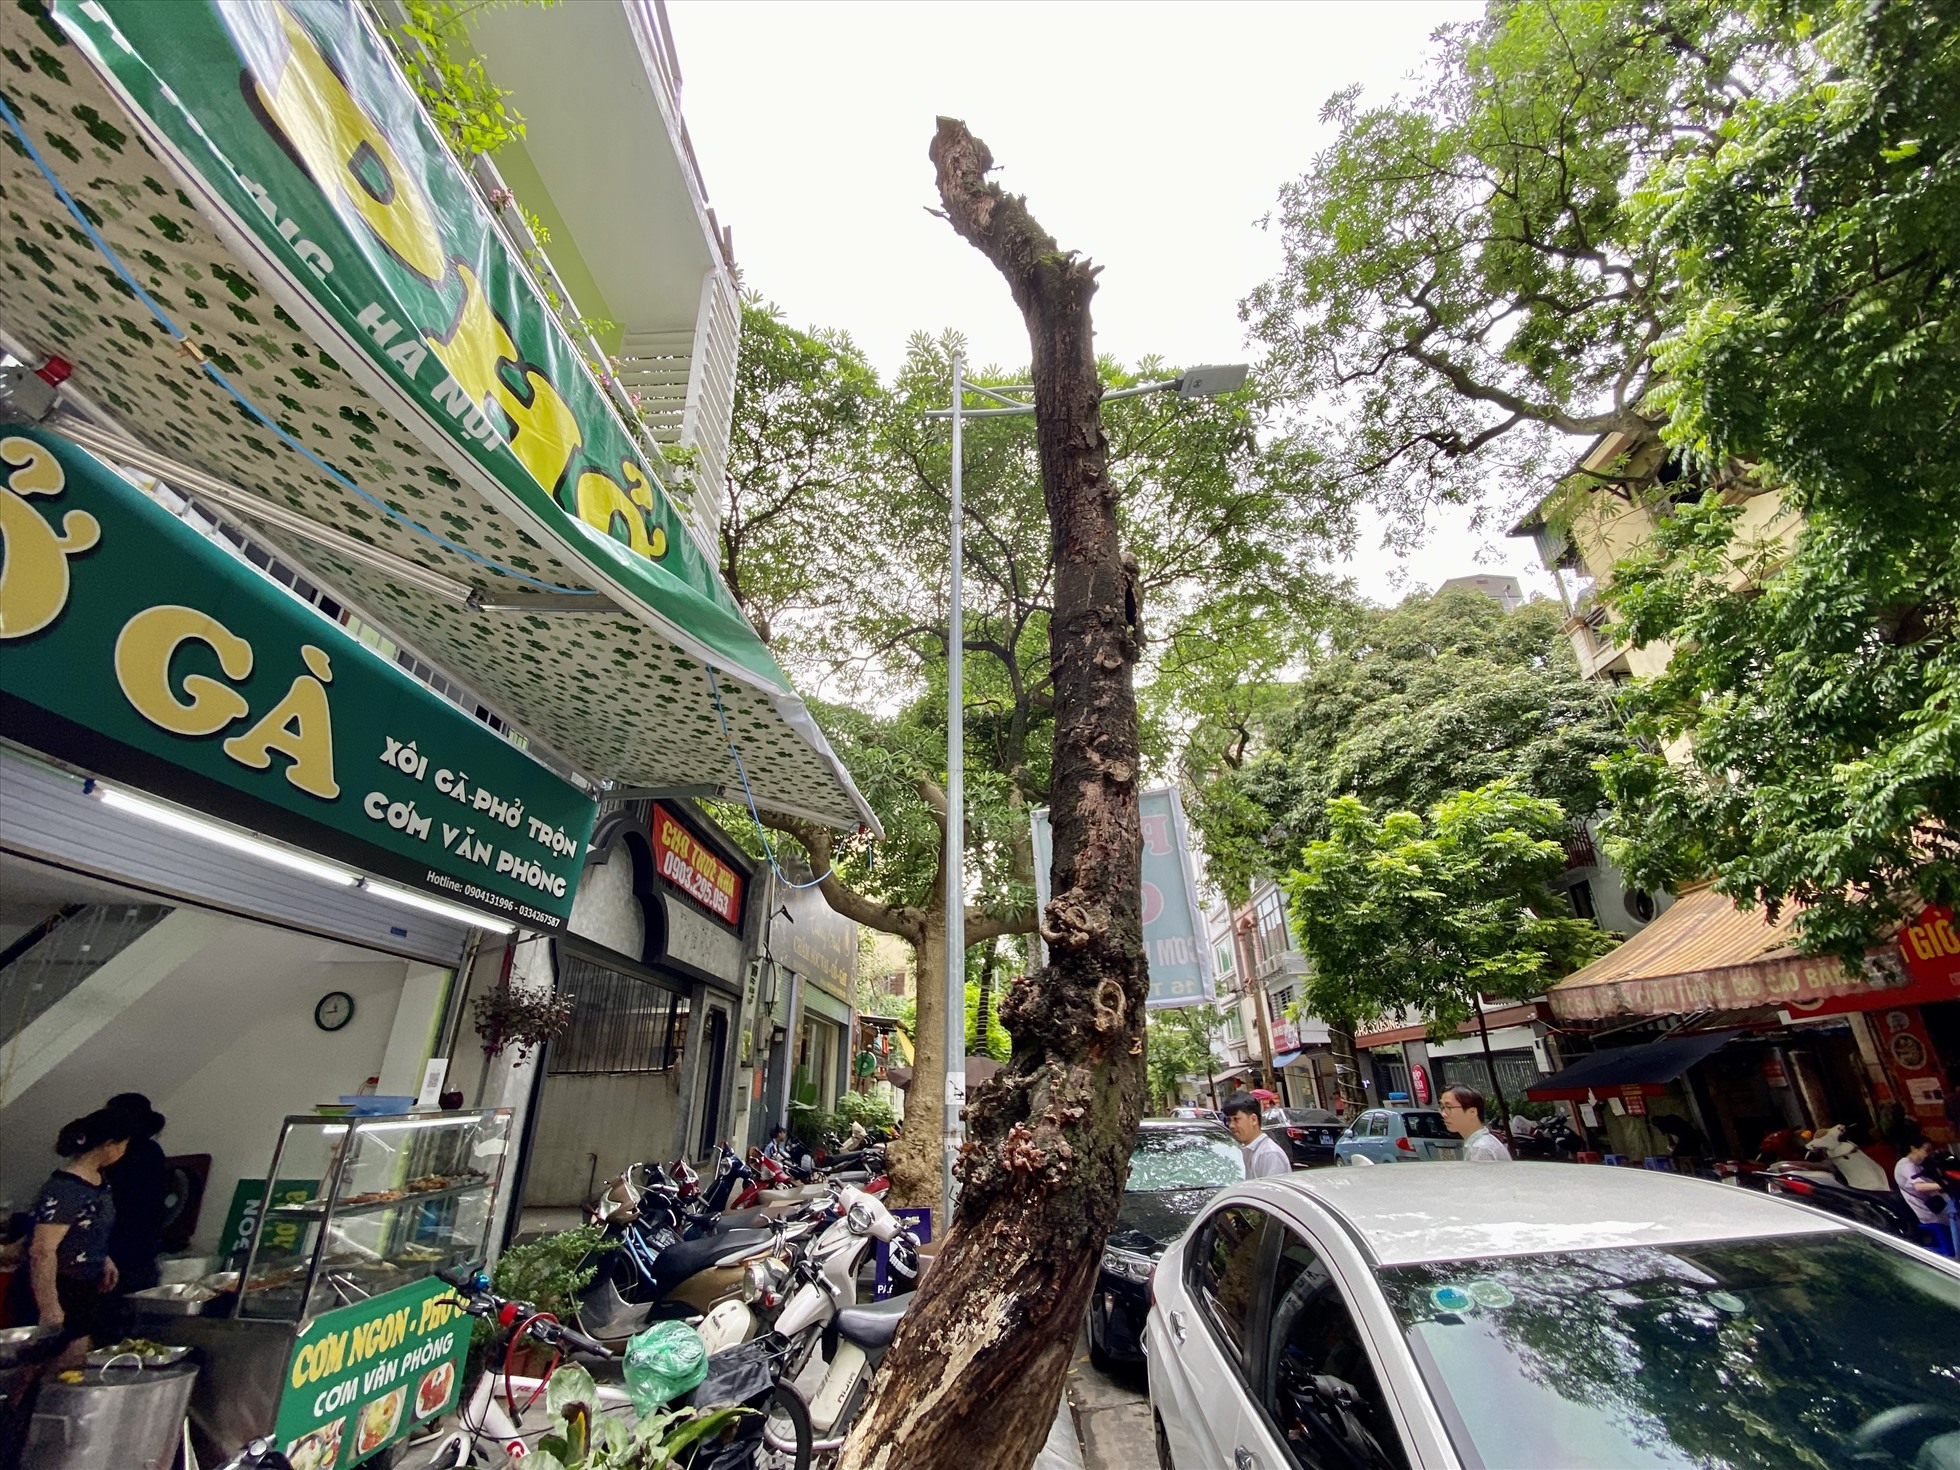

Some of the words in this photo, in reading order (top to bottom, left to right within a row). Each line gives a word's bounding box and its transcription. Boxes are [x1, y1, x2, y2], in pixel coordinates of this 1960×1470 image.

[115, 605, 340, 799] GÀ
[379, 736, 429, 781] XÔI
[528, 816, 578, 859] TRỘN
[661, 820, 690, 858] CHO
[363, 791, 432, 841] CƠM
[442, 823, 494, 866] VĂN
[496, 850, 568, 898] PHÒNG
[663, 850, 729, 915] 0903.295.053
[426, 870, 463, 893] Hotline:
[464, 884, 513, 911] 0904131996
[519, 905, 560, 928] 0334267587
[291, 1330, 349, 1389] CƠM
[347, 1307, 411, 1367] NGON
[313, 1376, 359, 1417] CƠM
[363, 1358, 398, 1395] VĂN
[400, 1332, 454, 1377] PHÒNG
